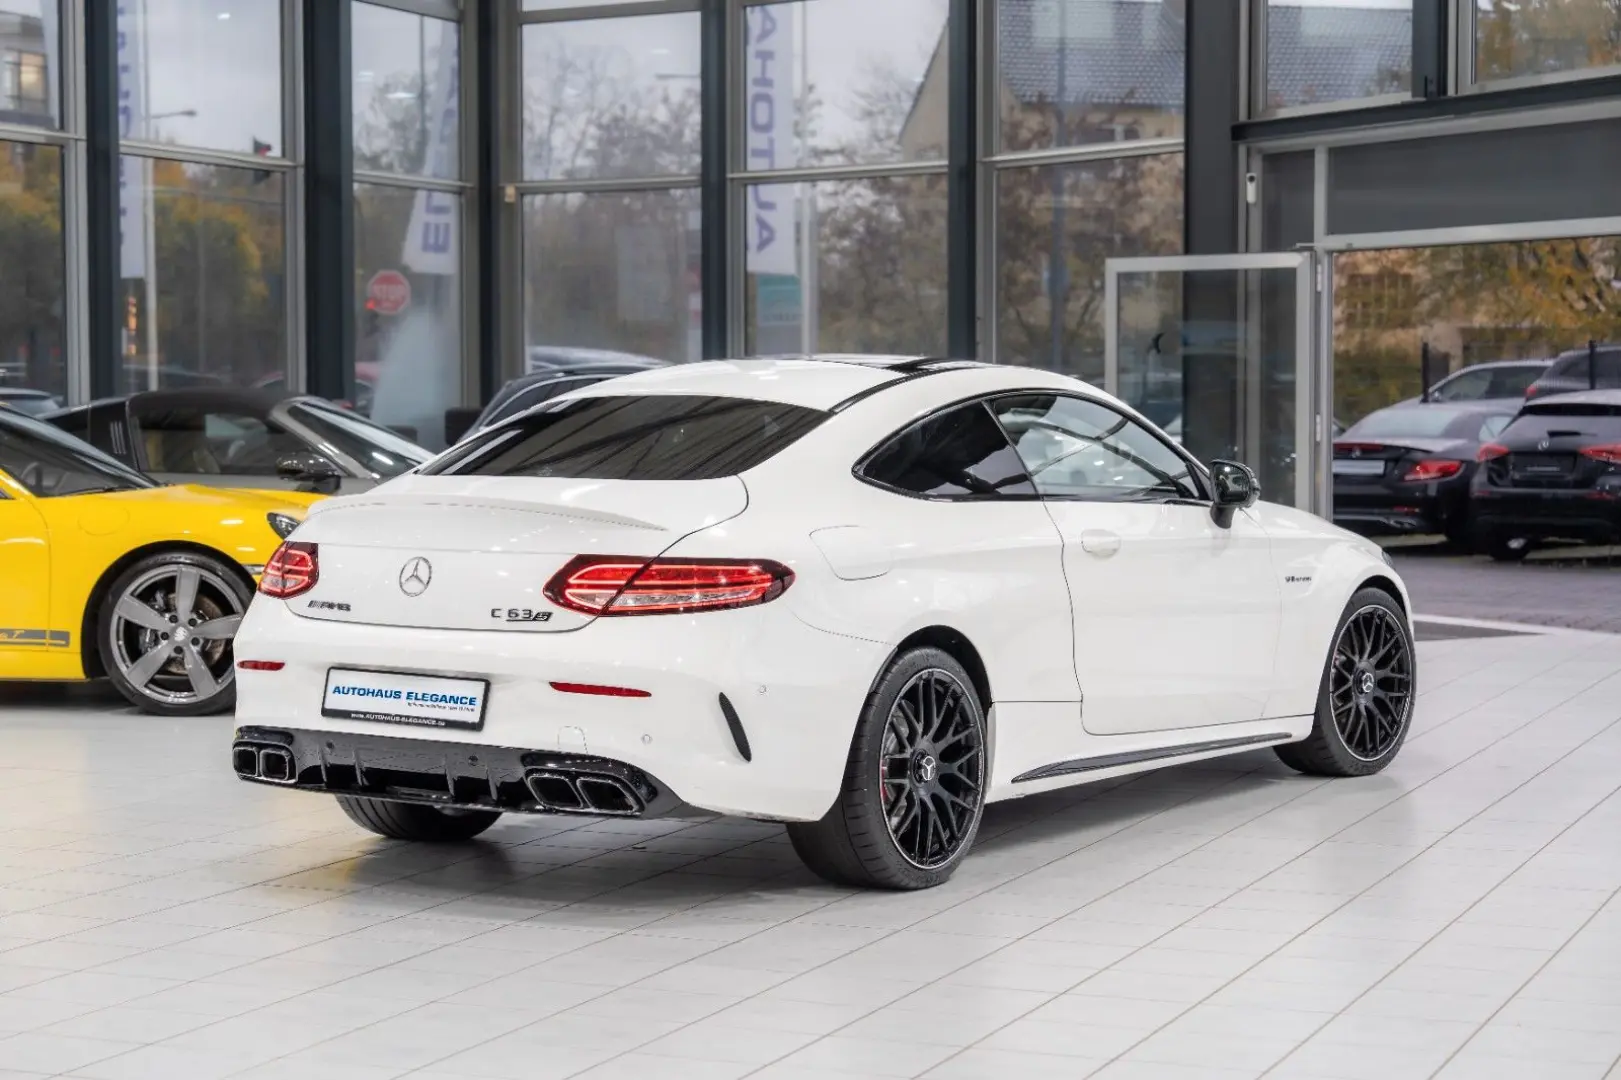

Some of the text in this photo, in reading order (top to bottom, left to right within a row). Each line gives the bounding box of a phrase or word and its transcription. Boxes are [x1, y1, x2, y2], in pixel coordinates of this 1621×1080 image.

[490, 608, 502, 619] C
[332, 685, 477, 706] AUTOHAUS ELEGANCE
